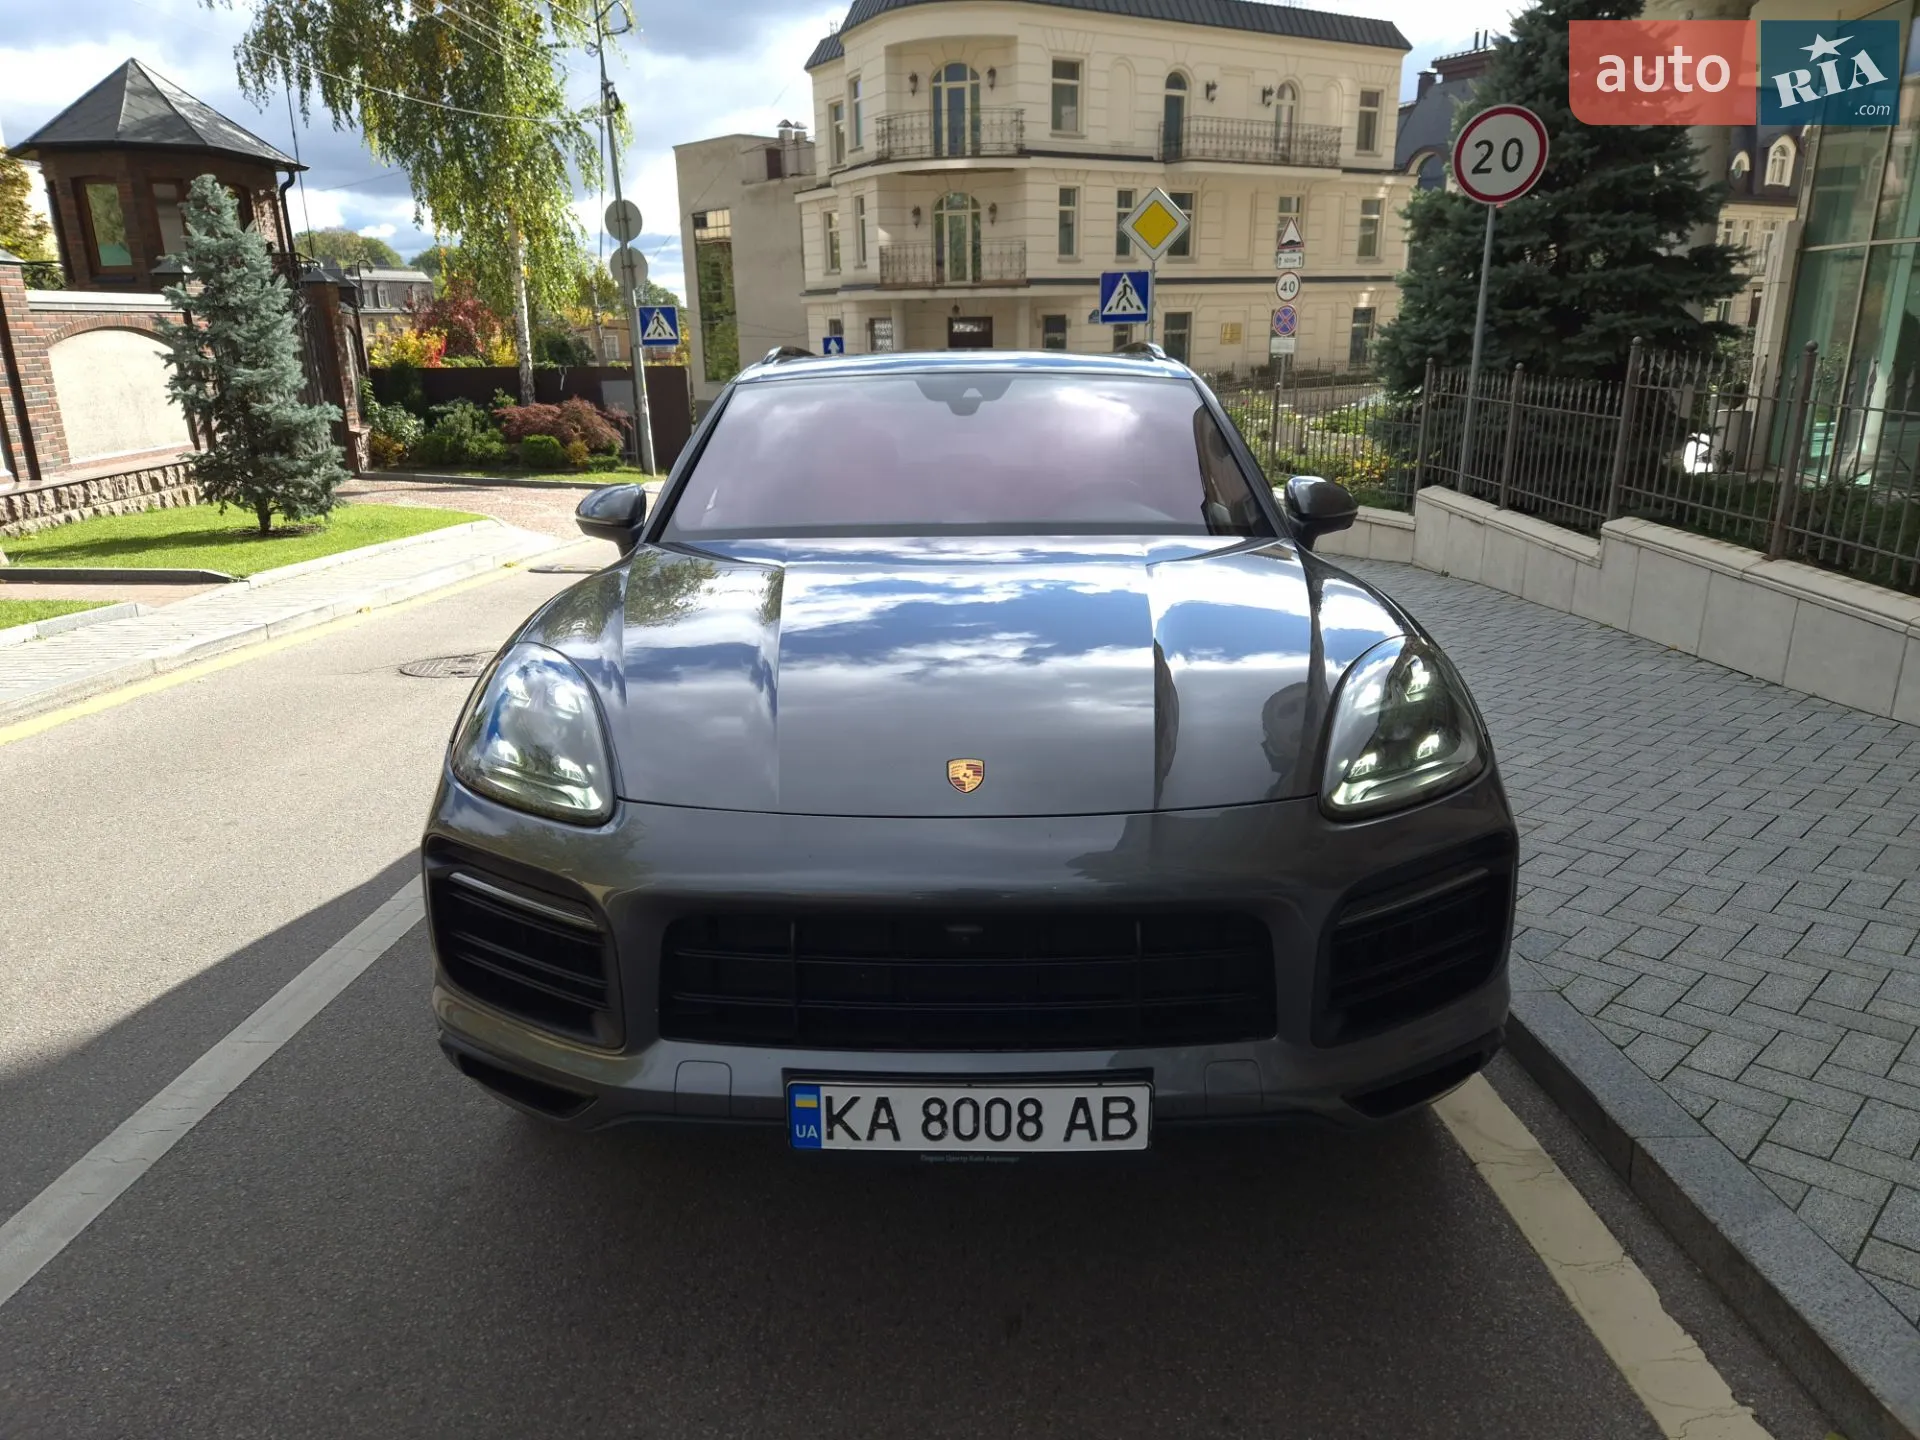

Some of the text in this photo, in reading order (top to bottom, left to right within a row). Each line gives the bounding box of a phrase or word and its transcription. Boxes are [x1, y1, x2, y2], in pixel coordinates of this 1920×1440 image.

[1471, 137, 1524, 175] 20
[1280, 280, 1296, 293] 40
[795, 1124, 819, 1140] UA
[825, 1095, 1139, 1143] KA 8008 AB
